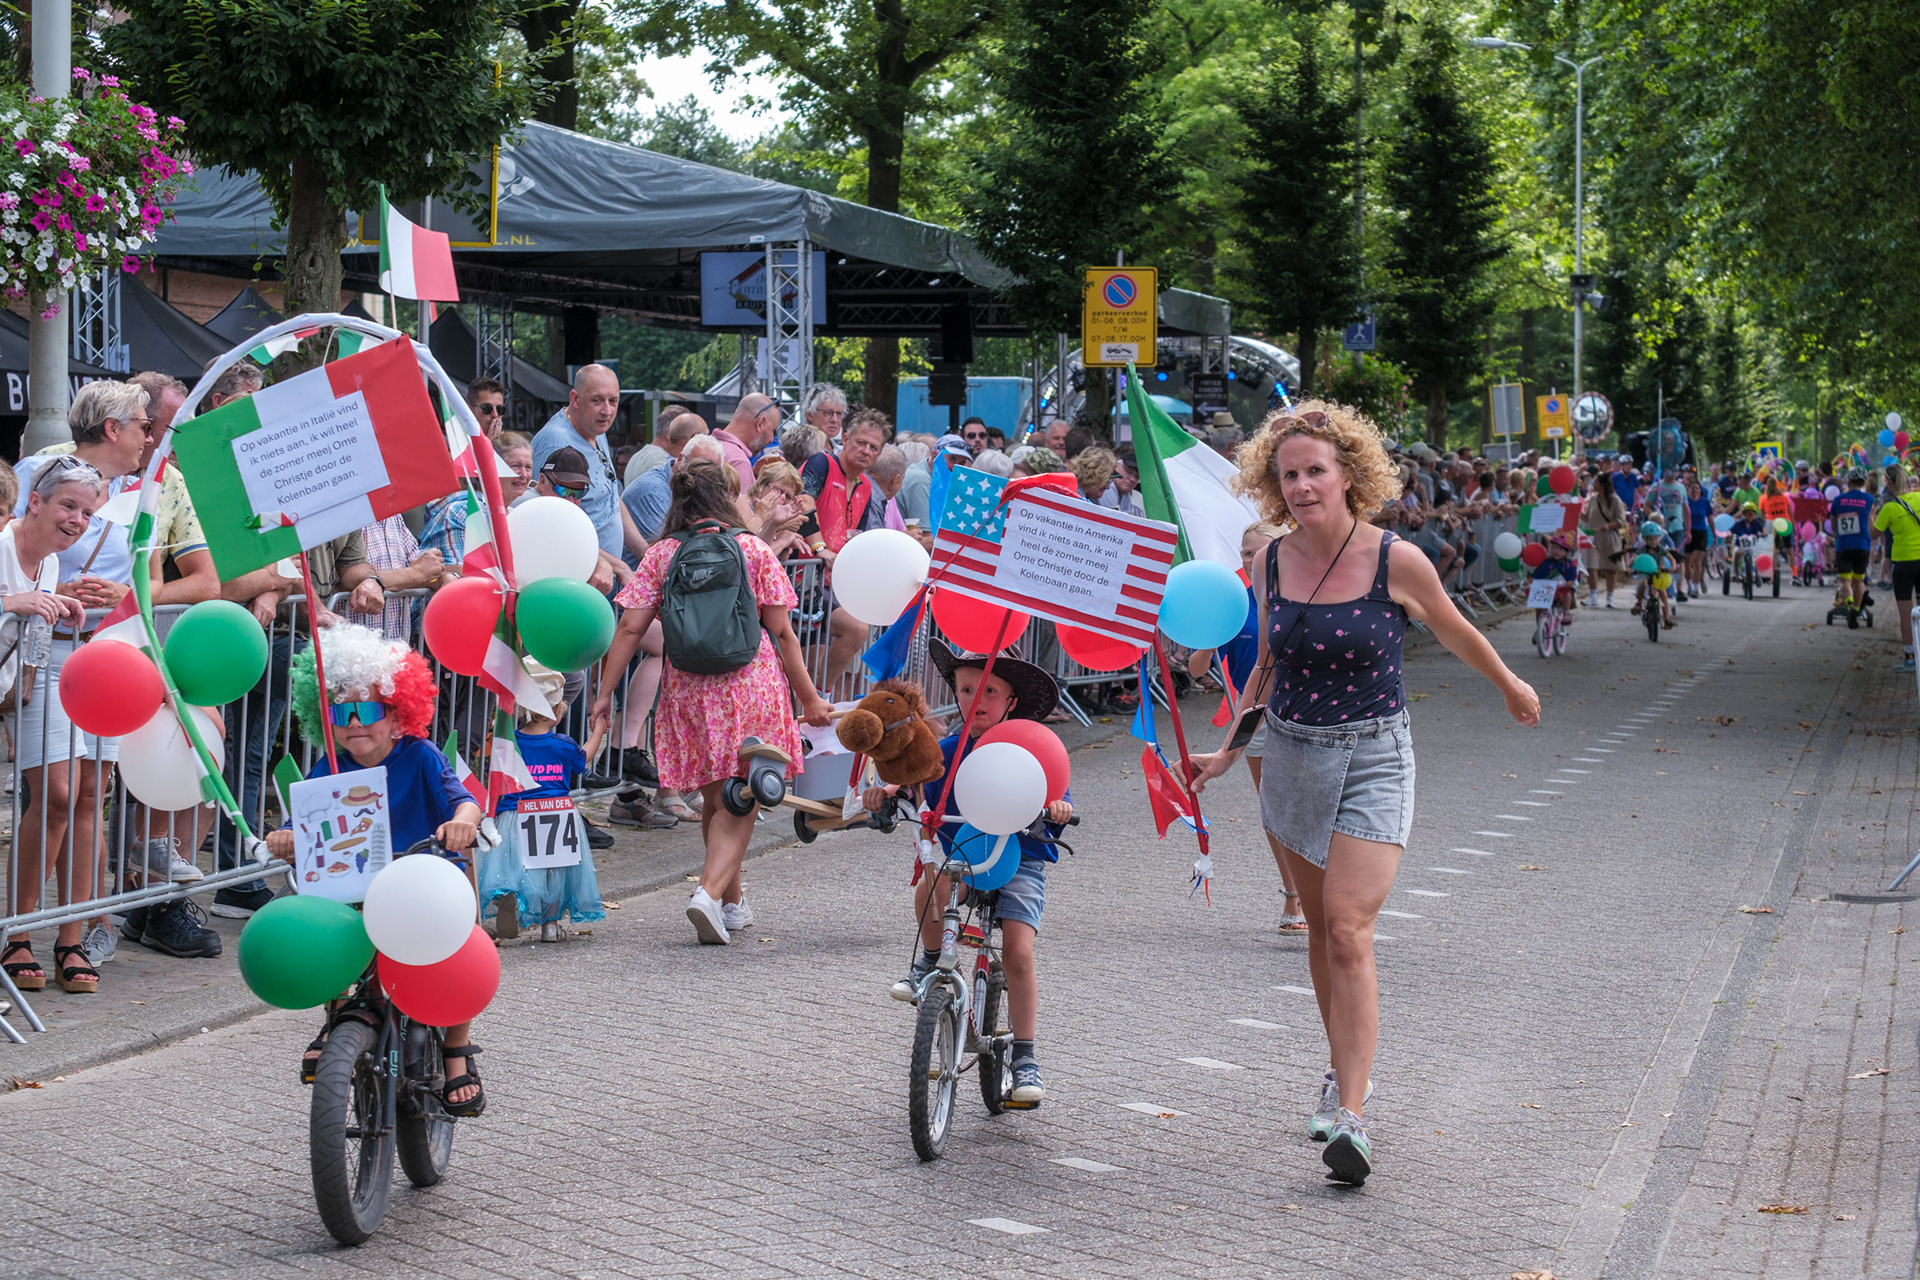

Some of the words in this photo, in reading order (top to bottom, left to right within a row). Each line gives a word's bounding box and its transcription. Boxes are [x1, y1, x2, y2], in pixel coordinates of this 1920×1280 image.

[240, 441, 256, 452] Op
[257, 425, 299, 447] vakantie
[300, 421, 310, 431] in
[311, 410, 336, 425] Italië
[337, 401, 359, 415] vind
[249, 455, 259, 466] ik
[260, 446, 285, 462] niets
[287, 439, 309, 452] aan,
[309, 433, 319, 443] ik
[320, 426, 335, 439] wil
[336, 418, 359, 433] heel
[260, 466, 273, 479] de
[275, 456, 305, 473] zomer
[307, 446, 332, 461] meej
[333, 436, 357, 450] Ome
[274, 468, 314, 490] Christje
[315, 459, 337, 474] door
[339, 454, 352, 465] de
[277, 479, 330, 505] Kolenbaan
[332, 471, 359, 487] gaan.
[1018, 524, 1037, 535] vind
[1039, 530, 1047, 538] ik
[1048, 533, 1071, 545] niets
[1072, 540, 1092, 553] aan,
[1095, 545, 1102, 554] ik
[1104, 550, 1118, 559] wil
[1020, 509, 1034, 520] Op
[1036, 513, 1074, 531] vakantie
[1075, 525, 1084, 534] in
[1085, 528, 1124, 545] Amerika
[1841, 517, 1855, 531] 57
[1013, 551, 1036, 565] Ome
[1037, 558, 1072, 576] Christje
[1074, 568, 1096, 582] door
[1097, 576, 1109, 586] de
[1020, 539, 1040, 551] heel
[1042, 545, 1054, 555] de
[1055, 550, 1084, 564] zomer
[1085, 558, 1109, 572] meej
[693, 566, 714, 581] NIKE
[1020, 568, 1068, 590] Kolenbaan
[1069, 583, 1094, 597] gaan.
[524, 801, 538, 811] HEL
[540, 800, 554, 810] VAN
[555, 799, 564, 808] DE
[521, 812, 578, 857] 174
